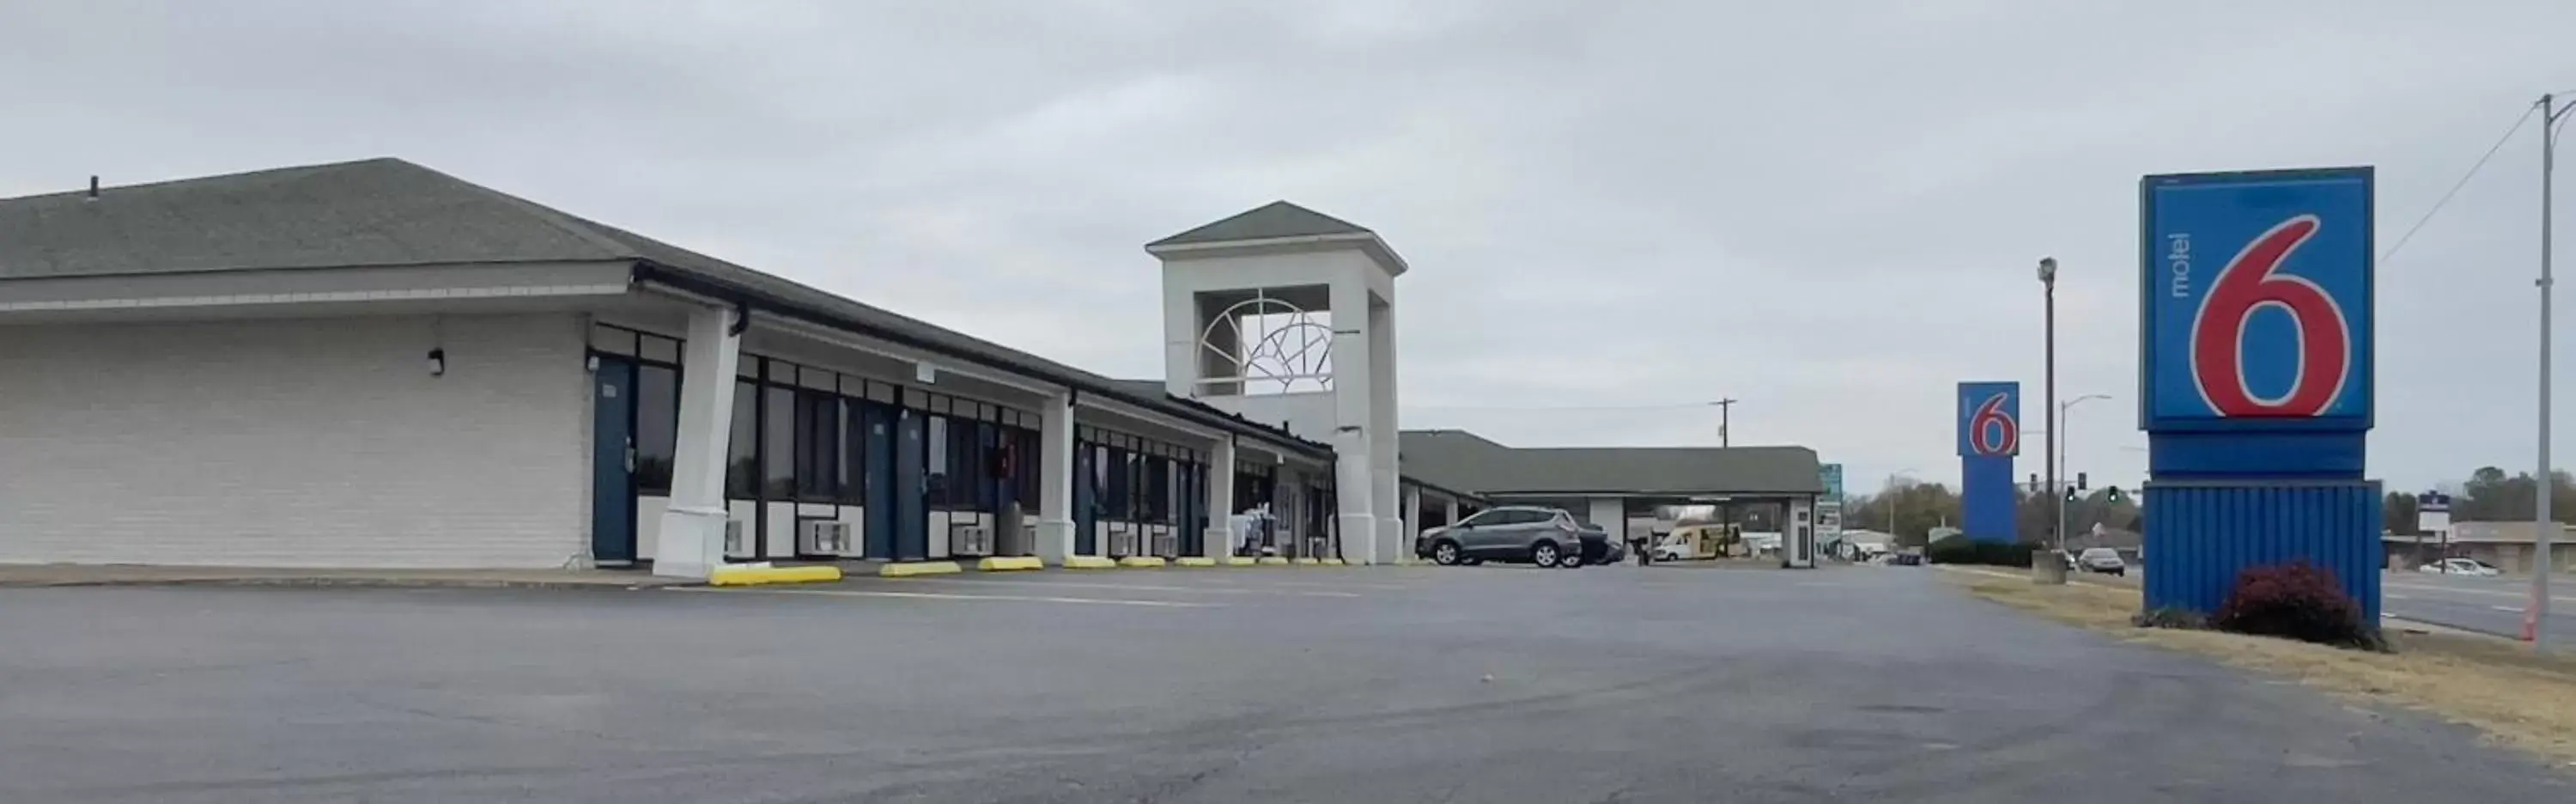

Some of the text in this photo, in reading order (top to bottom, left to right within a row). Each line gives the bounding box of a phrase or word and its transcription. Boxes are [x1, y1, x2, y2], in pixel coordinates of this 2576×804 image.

[2167, 233, 2190, 297] motel
[2190, 214, 2351, 417] 6
[1969, 392, 2017, 455] 6
